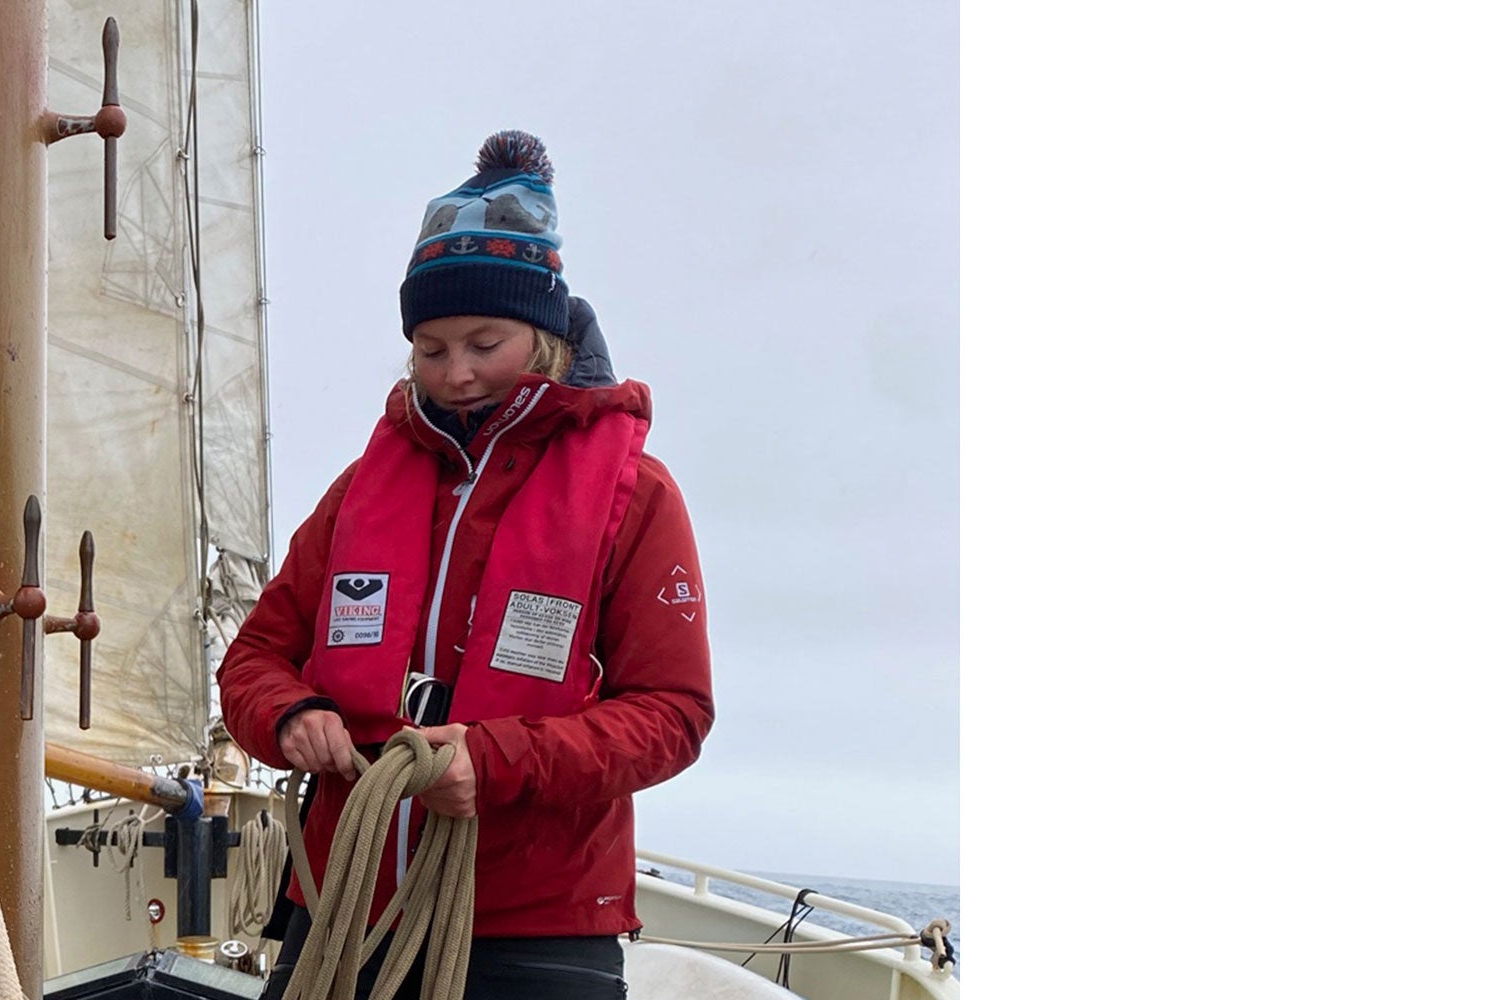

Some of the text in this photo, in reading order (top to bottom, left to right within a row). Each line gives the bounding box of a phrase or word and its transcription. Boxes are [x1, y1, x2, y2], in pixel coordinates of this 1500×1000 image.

[483, 386, 531, 436] salomon
[513, 593, 579, 610] SOLAS FRONT
[334, 605, 381, 617] VIKING
